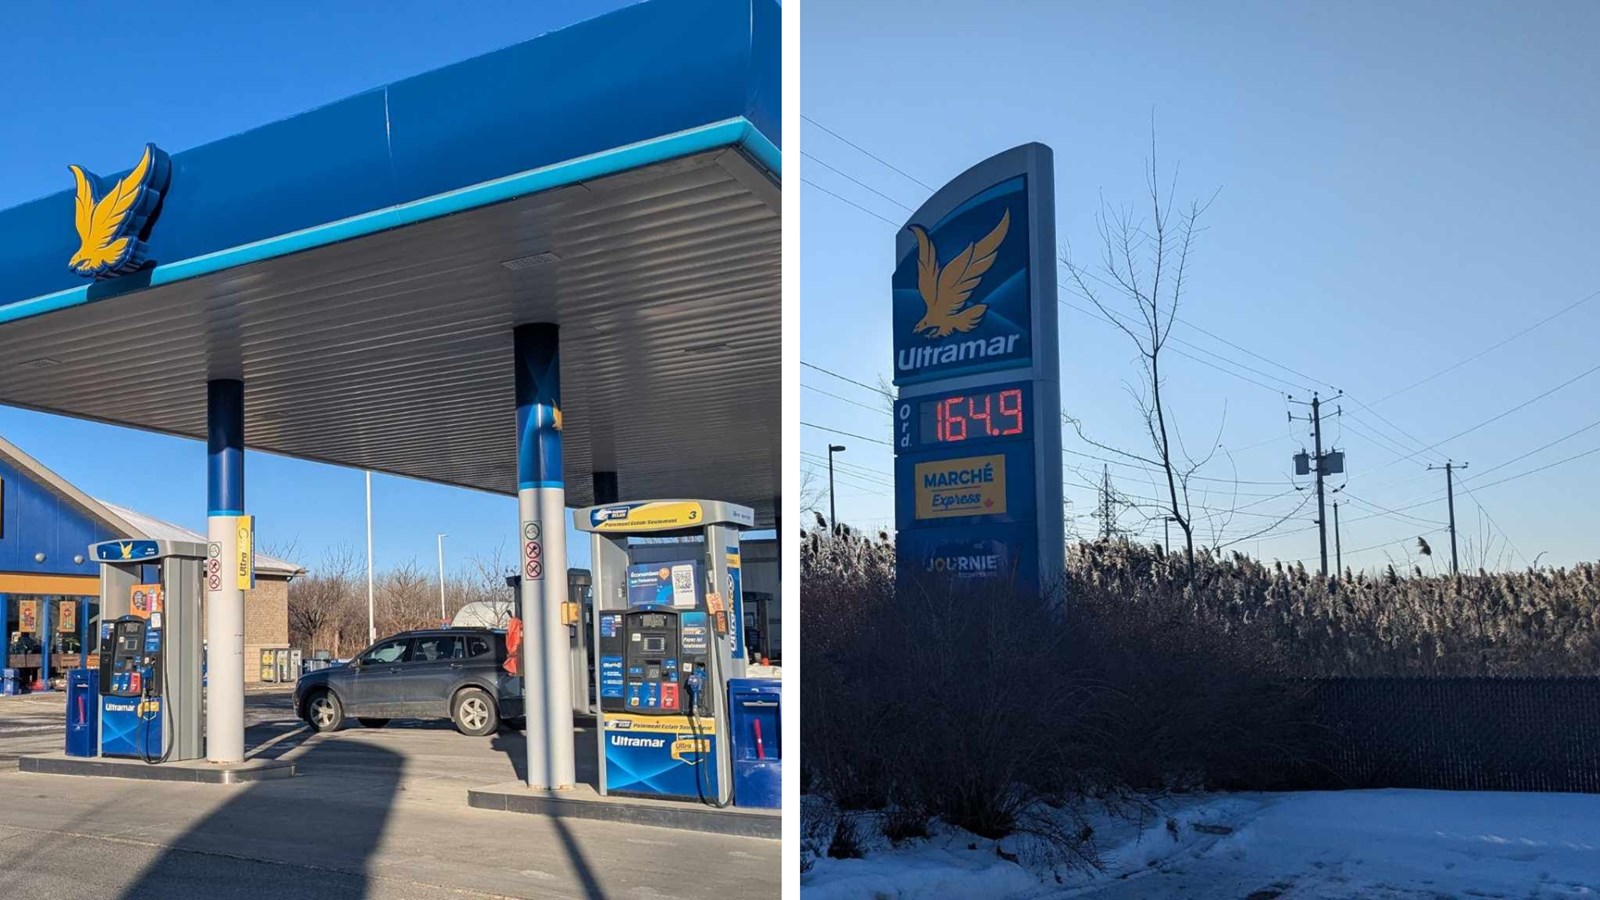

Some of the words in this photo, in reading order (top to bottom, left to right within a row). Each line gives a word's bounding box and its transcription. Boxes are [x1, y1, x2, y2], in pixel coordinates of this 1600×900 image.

[897, 333, 1021, 371] Ultramar
[936, 388, 1023, 442] 164.9
[924, 463, 995, 488] MARCHÉ
[931, 490, 982, 508] Express
[688, 510, 697, 519] 3
[925, 554, 998, 573] JOURNIE
[105, 703, 135, 712] Ultramar
[611, 735, 665, 748] Ultramar
